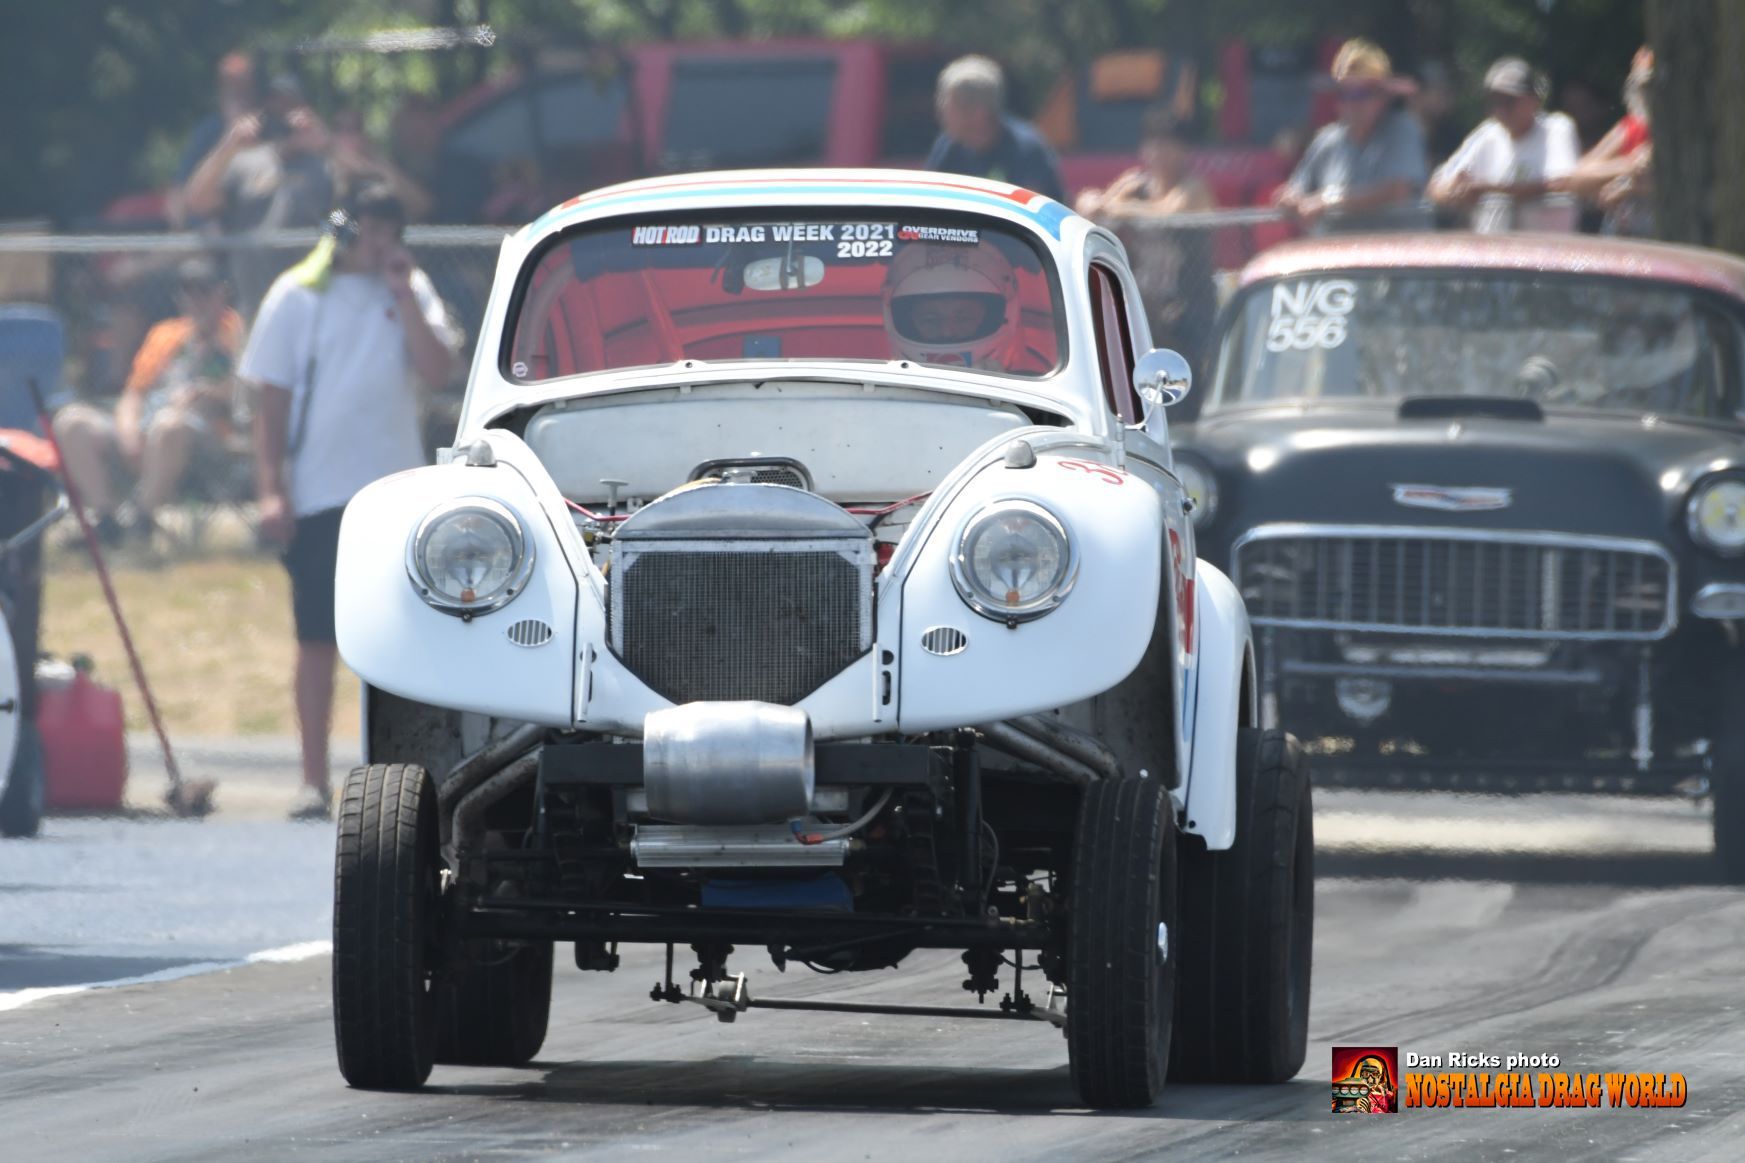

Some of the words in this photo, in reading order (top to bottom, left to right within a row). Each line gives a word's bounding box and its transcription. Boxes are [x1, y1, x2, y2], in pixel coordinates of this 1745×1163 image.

[706, 226, 765, 243] DRAG
[772, 225, 834, 242] WEEK
[841, 224, 895, 241] 2021
[902, 226, 977, 238] OVERDRIVE
[918, 232, 939, 241] GEAR
[837, 240, 893, 258] 2022
[1271, 279, 1358, 317] N/G
[1266, 316, 1347, 352] 556
